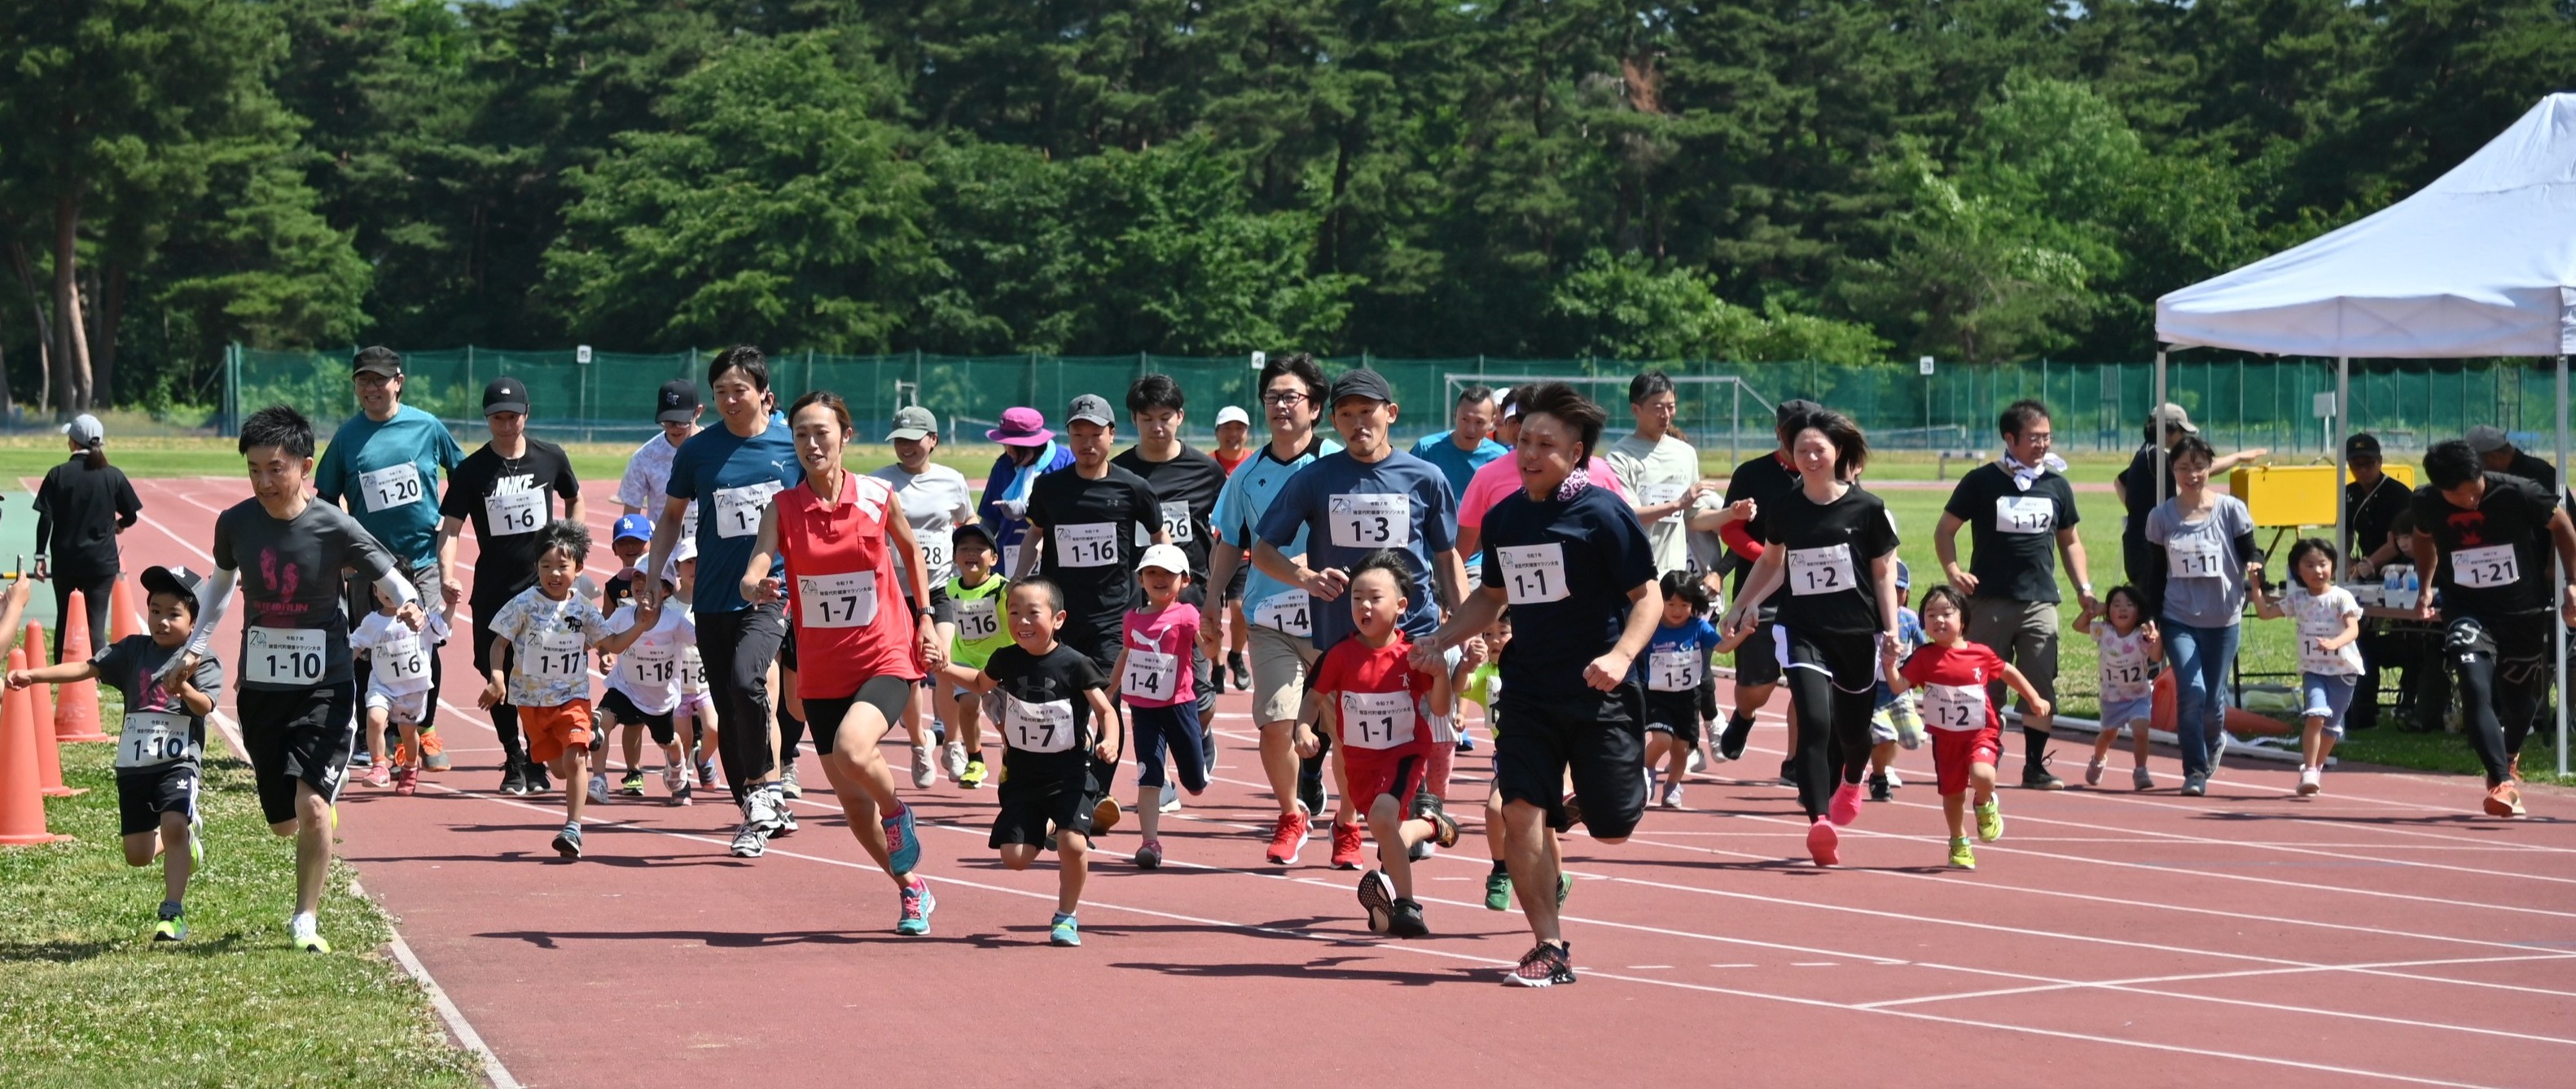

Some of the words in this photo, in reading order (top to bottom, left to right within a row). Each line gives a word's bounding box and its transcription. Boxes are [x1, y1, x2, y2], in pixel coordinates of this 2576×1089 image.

[379, 479, 418, 504] 1-20
[495, 473, 534, 496] NIKE
[504, 508, 534, 530] 1-6
[1351, 516, 1390, 542] 1-3
[2013, 513, 2049, 529] 1-12
[1072, 540, 1113, 562] 1-16
[2182, 555, 2217, 573] 1-11
[2471, 560, 2514, 584] 1-21
[1515, 569, 1547, 598] 1-1
[1806, 566, 1838, 589] 1-2
[819, 595, 857, 622] 1-7
[958, 614, 996, 635] 1-16
[1274, 608, 1309, 632] 1-4
[266, 652, 321, 678] 1-10
[391, 655, 420, 677] 1-6
[541, 652, 580, 674] 1-17
[636, 661, 674, 682] 1-18
[1130, 672, 1159, 694] 1-4
[1665, 668, 1692, 687] 1-5
[2106, 666, 2141, 683] 1-12
[1938, 705, 1969, 726] 1-2
[1019, 724, 1055, 747] 1-7
[1358, 716, 1393, 742] 1-1
[134, 736, 183, 761] 1-10
